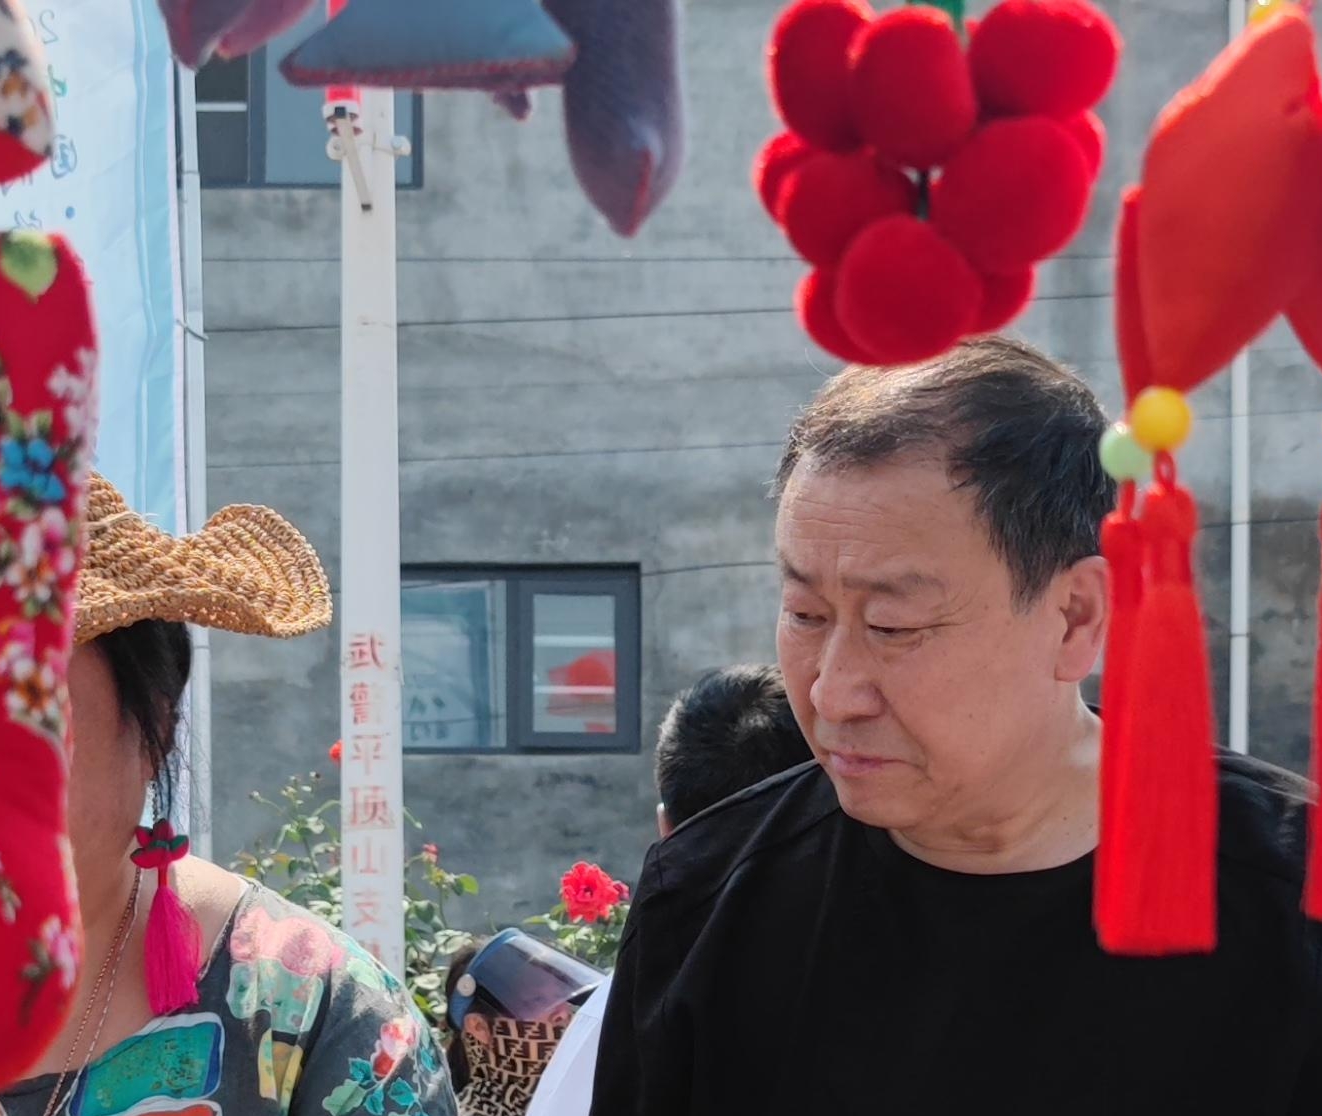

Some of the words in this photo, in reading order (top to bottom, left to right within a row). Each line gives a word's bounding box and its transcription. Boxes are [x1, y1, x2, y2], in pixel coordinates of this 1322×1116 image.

[349, 632, 388, 962] 武警平顶山支
